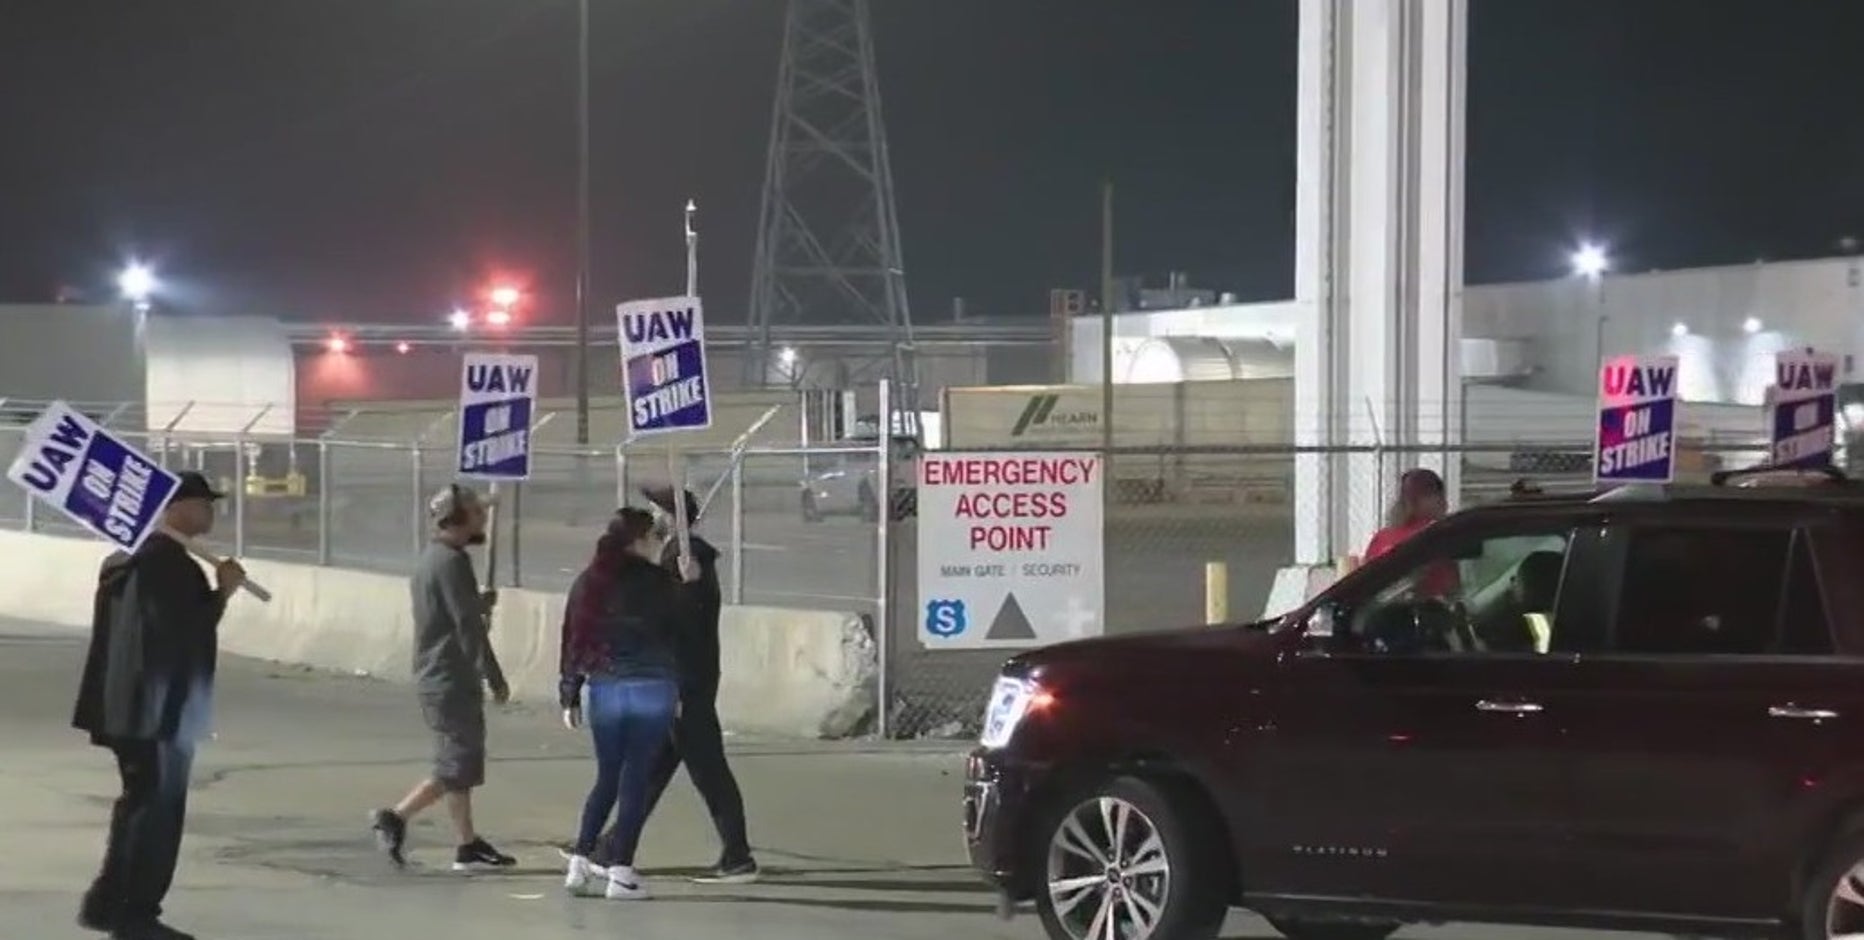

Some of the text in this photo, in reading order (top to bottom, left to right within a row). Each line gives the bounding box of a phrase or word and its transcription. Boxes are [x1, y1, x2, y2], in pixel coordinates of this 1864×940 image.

[623, 308, 693, 342] UAW
[468, 365, 531, 392] UAW
[652, 352, 679, 386] ON
[1605, 366, 1673, 395] UAW
[1778, 363, 1834, 389] UAW
[634, 376, 702, 425] STRIKE
[1624, 408, 1650, 437] ON
[22, 415, 89, 491] UAW
[1601, 431, 1669, 474] STRIKE
[82, 458, 116, 500] ON
[924, 459, 1094, 485] EMERGENCY
[104, 454, 153, 542] STRIKE
[955, 492, 1067, 518] ACCESS
[970, 526, 1052, 551] POINT
[940, 565, 971, 577] MAIN
[975, 565, 1005, 577] GATE
[1022, 563, 1081, 577] SECURITY
